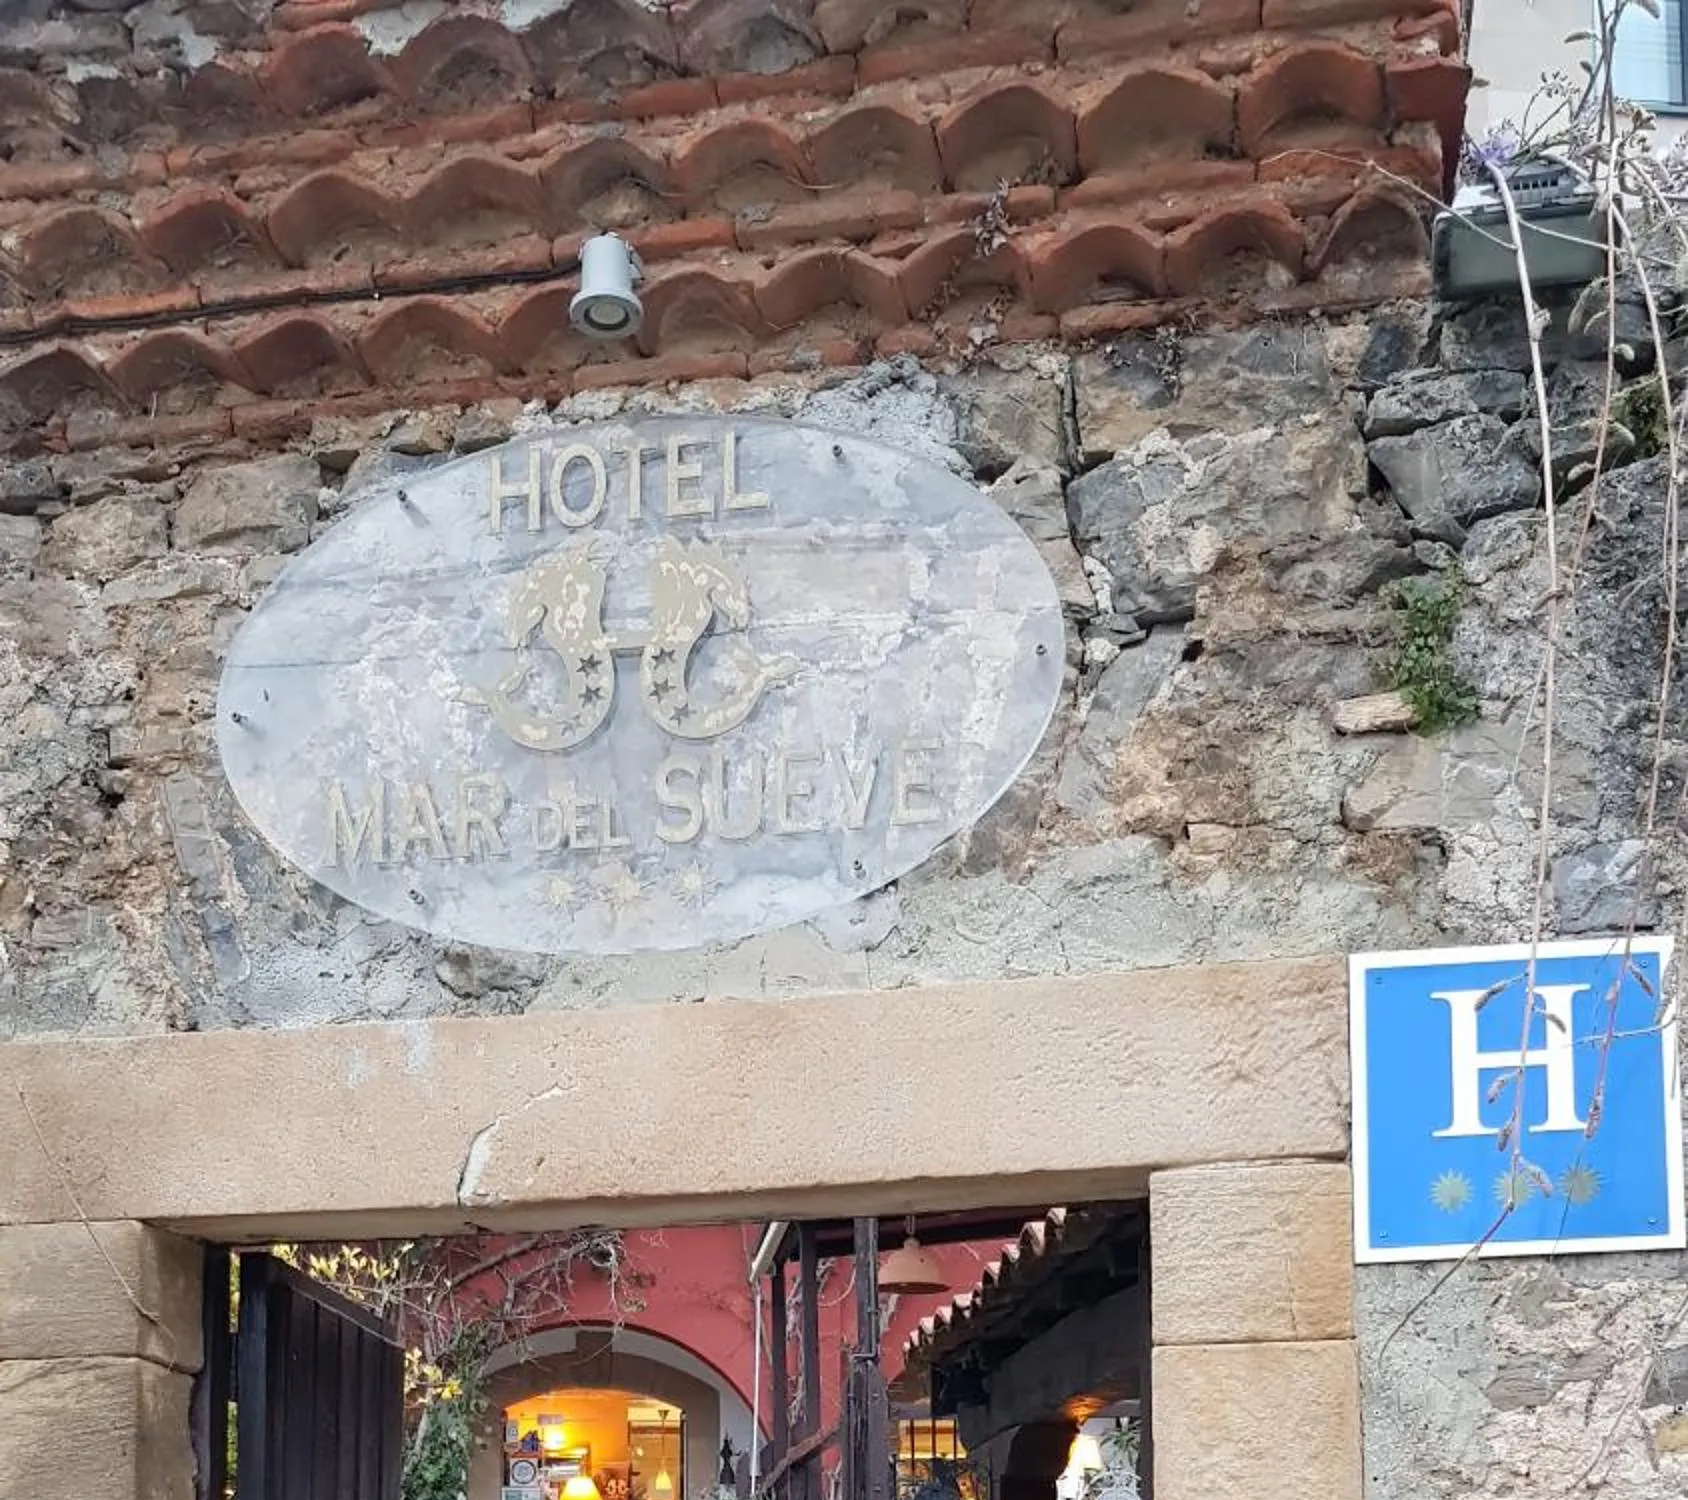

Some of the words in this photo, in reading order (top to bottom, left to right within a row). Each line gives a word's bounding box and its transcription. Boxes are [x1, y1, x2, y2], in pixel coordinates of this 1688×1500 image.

[489, 430, 770, 535] HOTEL
[321, 770, 511, 868] MAR
[532, 797, 631, 850] DEL
[655, 738, 945, 843] SUEVE
[1429, 983, 1592, 1137] H
